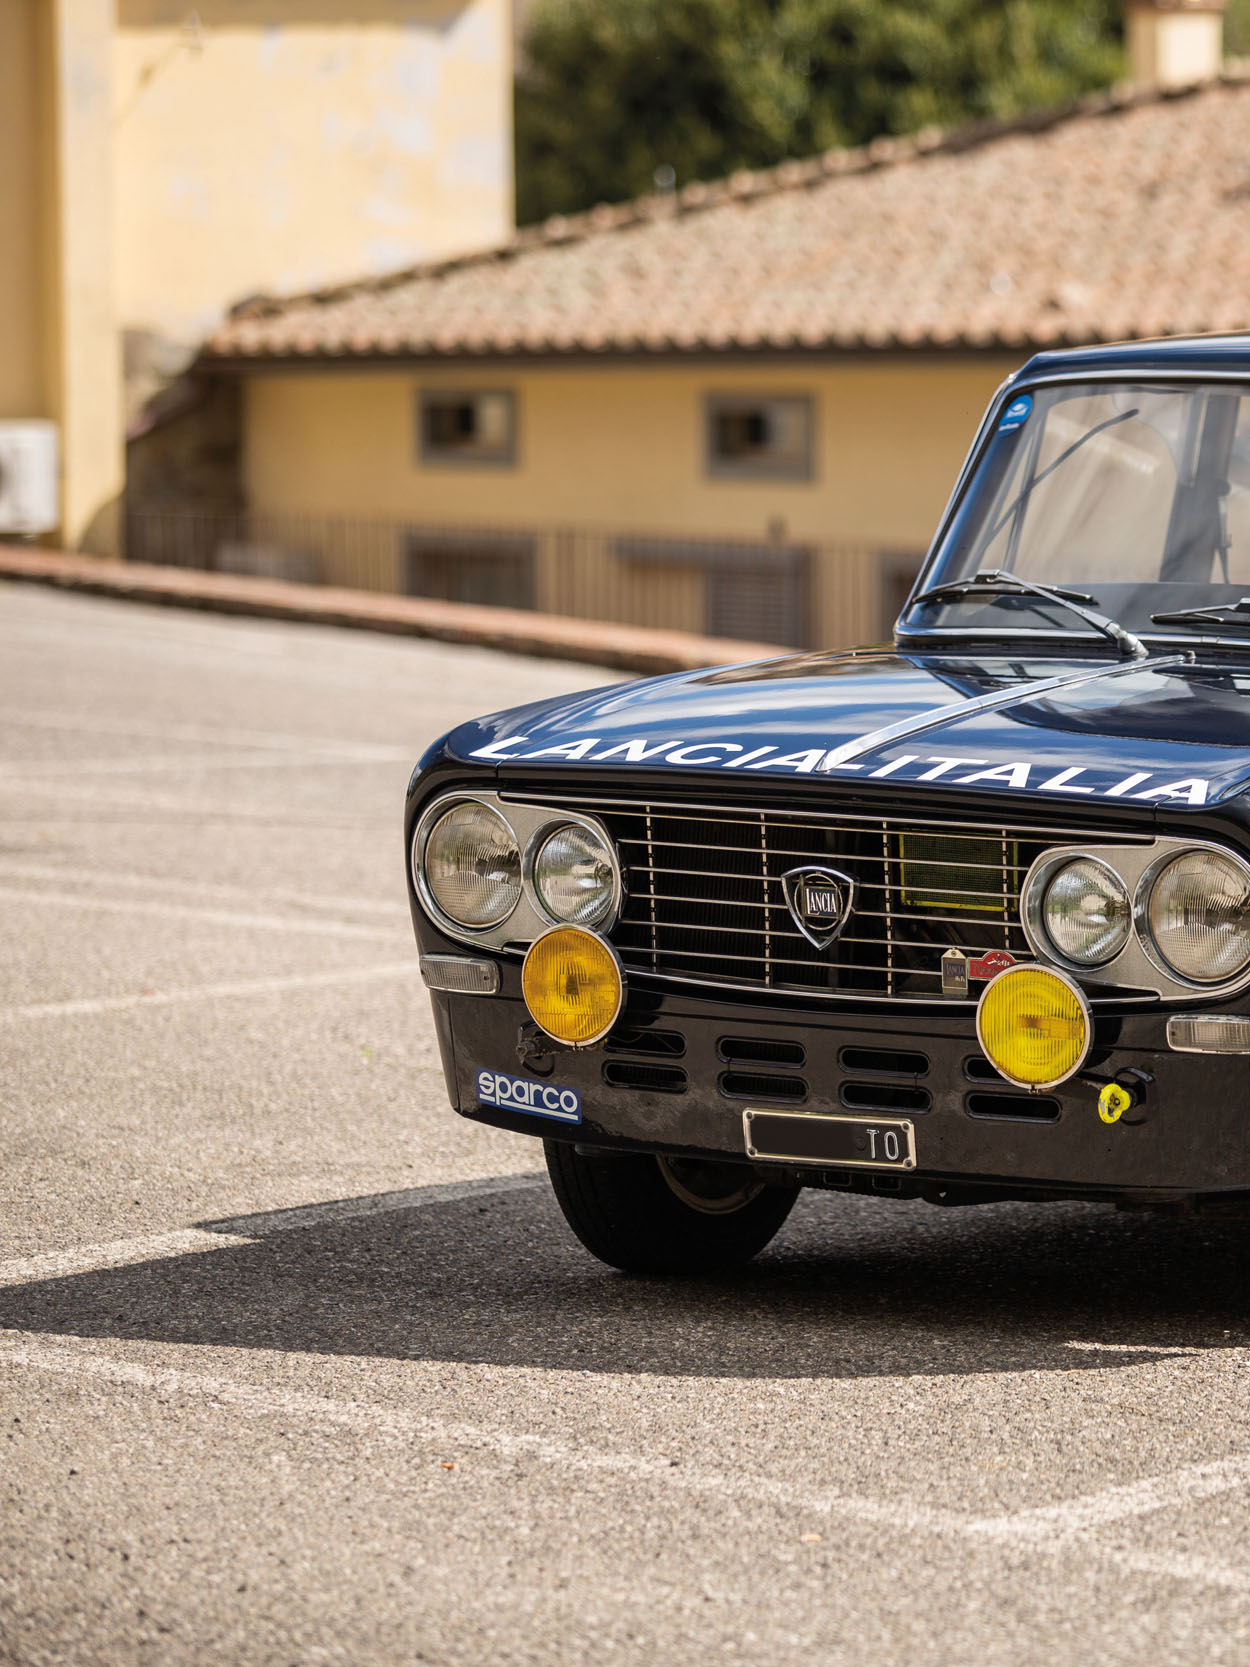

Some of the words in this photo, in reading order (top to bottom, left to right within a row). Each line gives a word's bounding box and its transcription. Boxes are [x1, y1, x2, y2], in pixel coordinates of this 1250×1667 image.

[805, 888, 837, 915] LANCIA
[479, 1071, 578, 1113] sparco
[866, 1128, 899, 1161] TO
